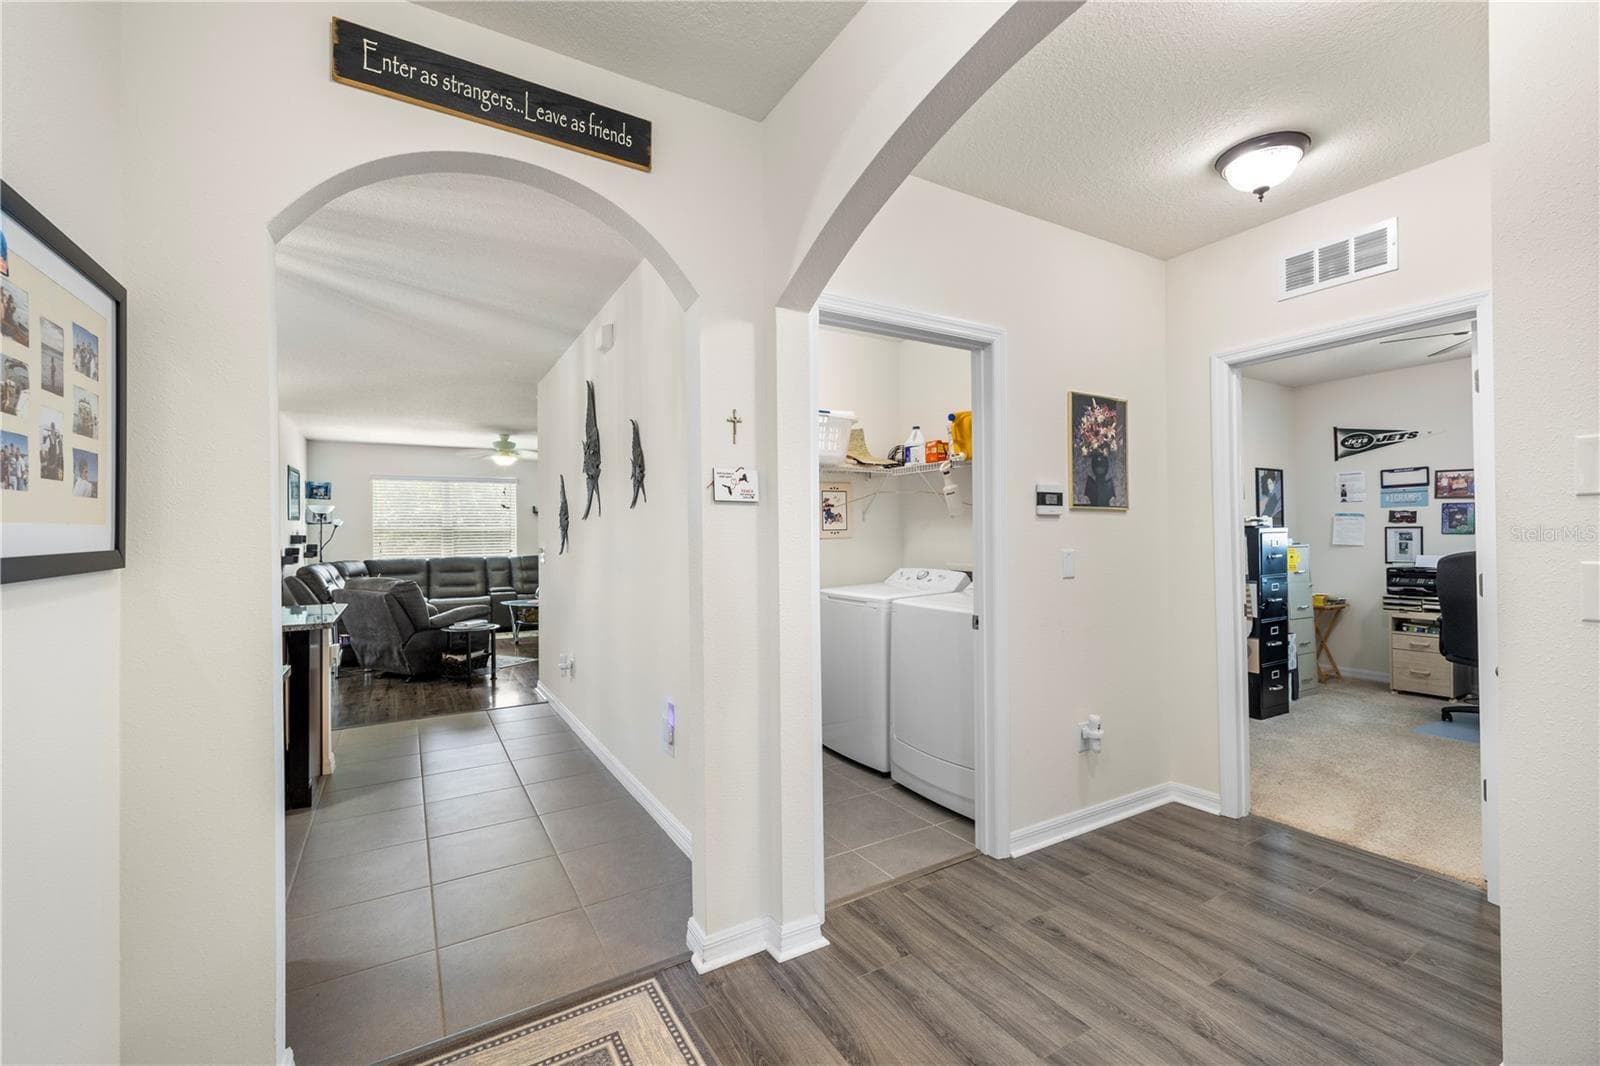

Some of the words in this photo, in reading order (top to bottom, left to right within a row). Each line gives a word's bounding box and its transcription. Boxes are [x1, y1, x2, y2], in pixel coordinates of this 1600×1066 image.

[362, 38, 417, 80] Enter
[420, 70, 438, 87] as
[571, 117, 586, 133] as
[588, 112, 632, 148] friends
[1376, 431, 1419, 442] JETS
